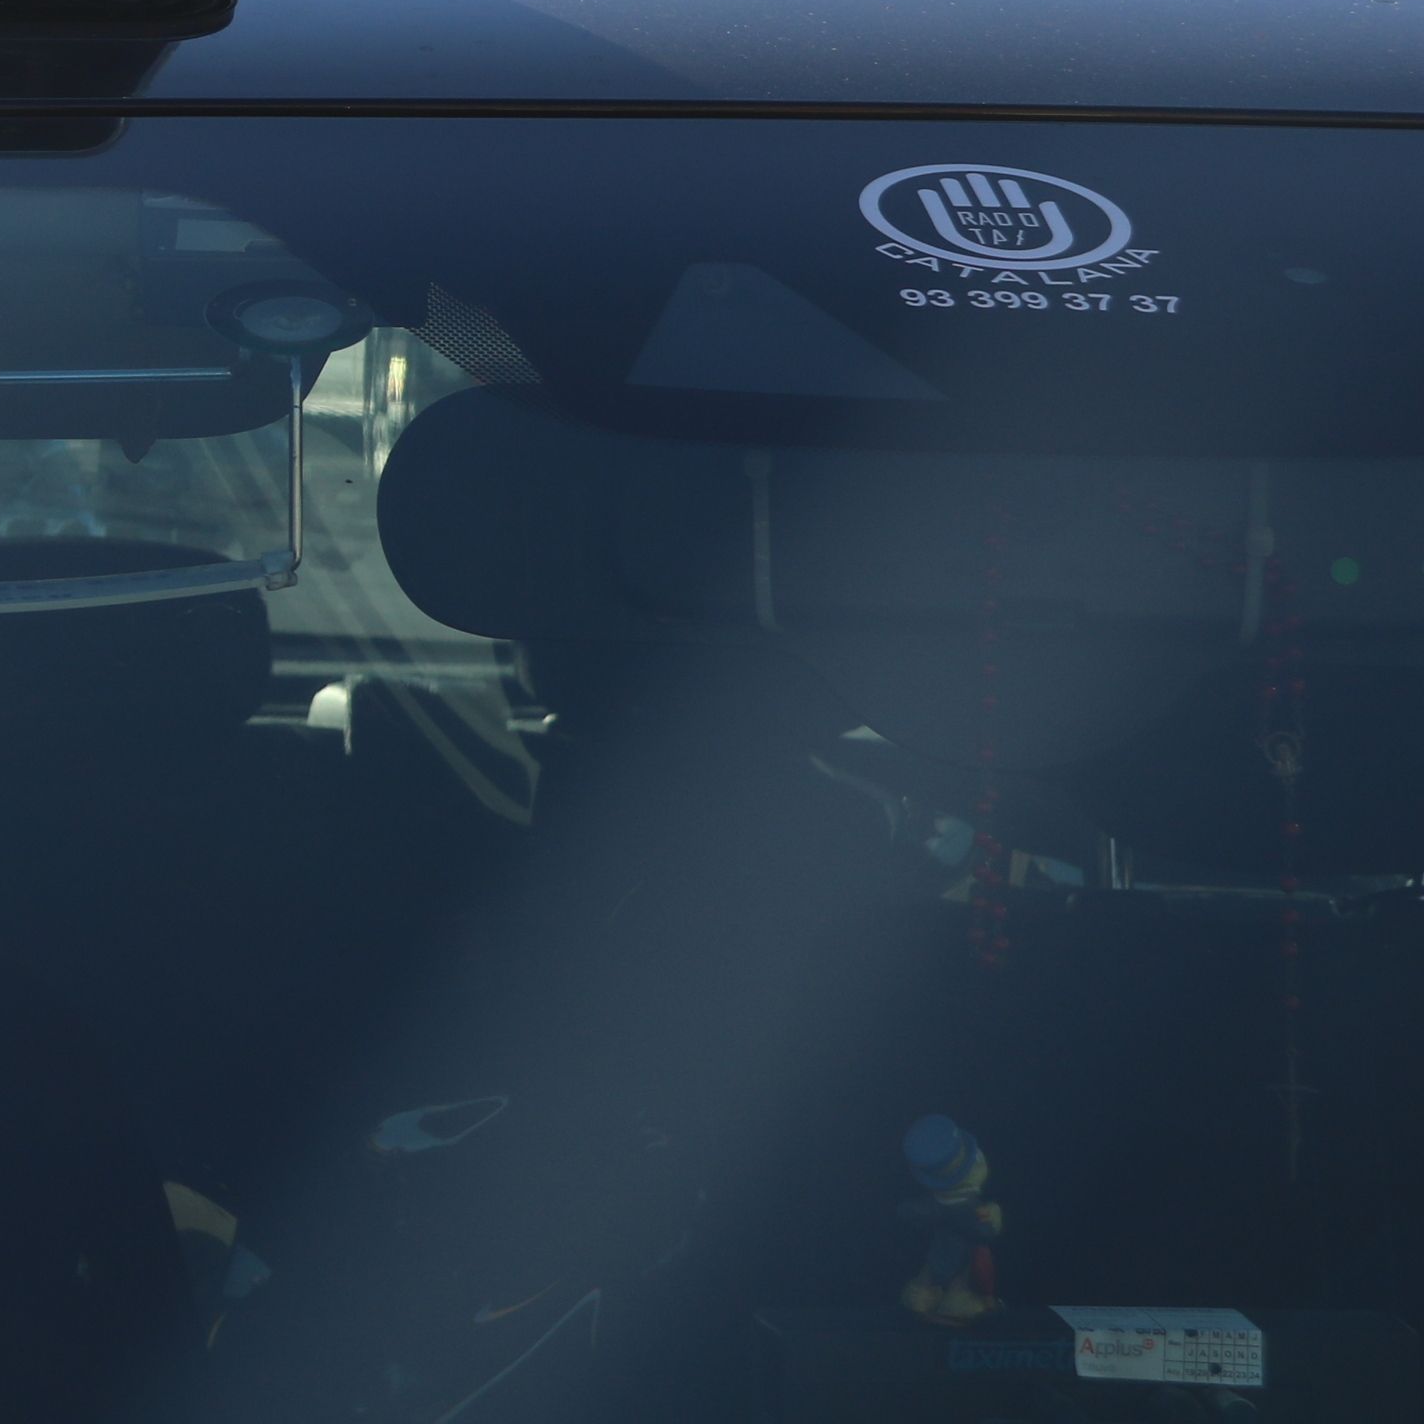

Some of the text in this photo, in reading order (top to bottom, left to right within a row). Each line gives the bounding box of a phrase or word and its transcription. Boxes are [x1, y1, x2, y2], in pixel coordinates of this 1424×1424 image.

[956, 211, 1041, 227] RADO
[968, 228, 1025, 245] TA
[875, 246, 1162, 285] CATALANA
[900, 288, 1180, 314] 93 399 37 37
